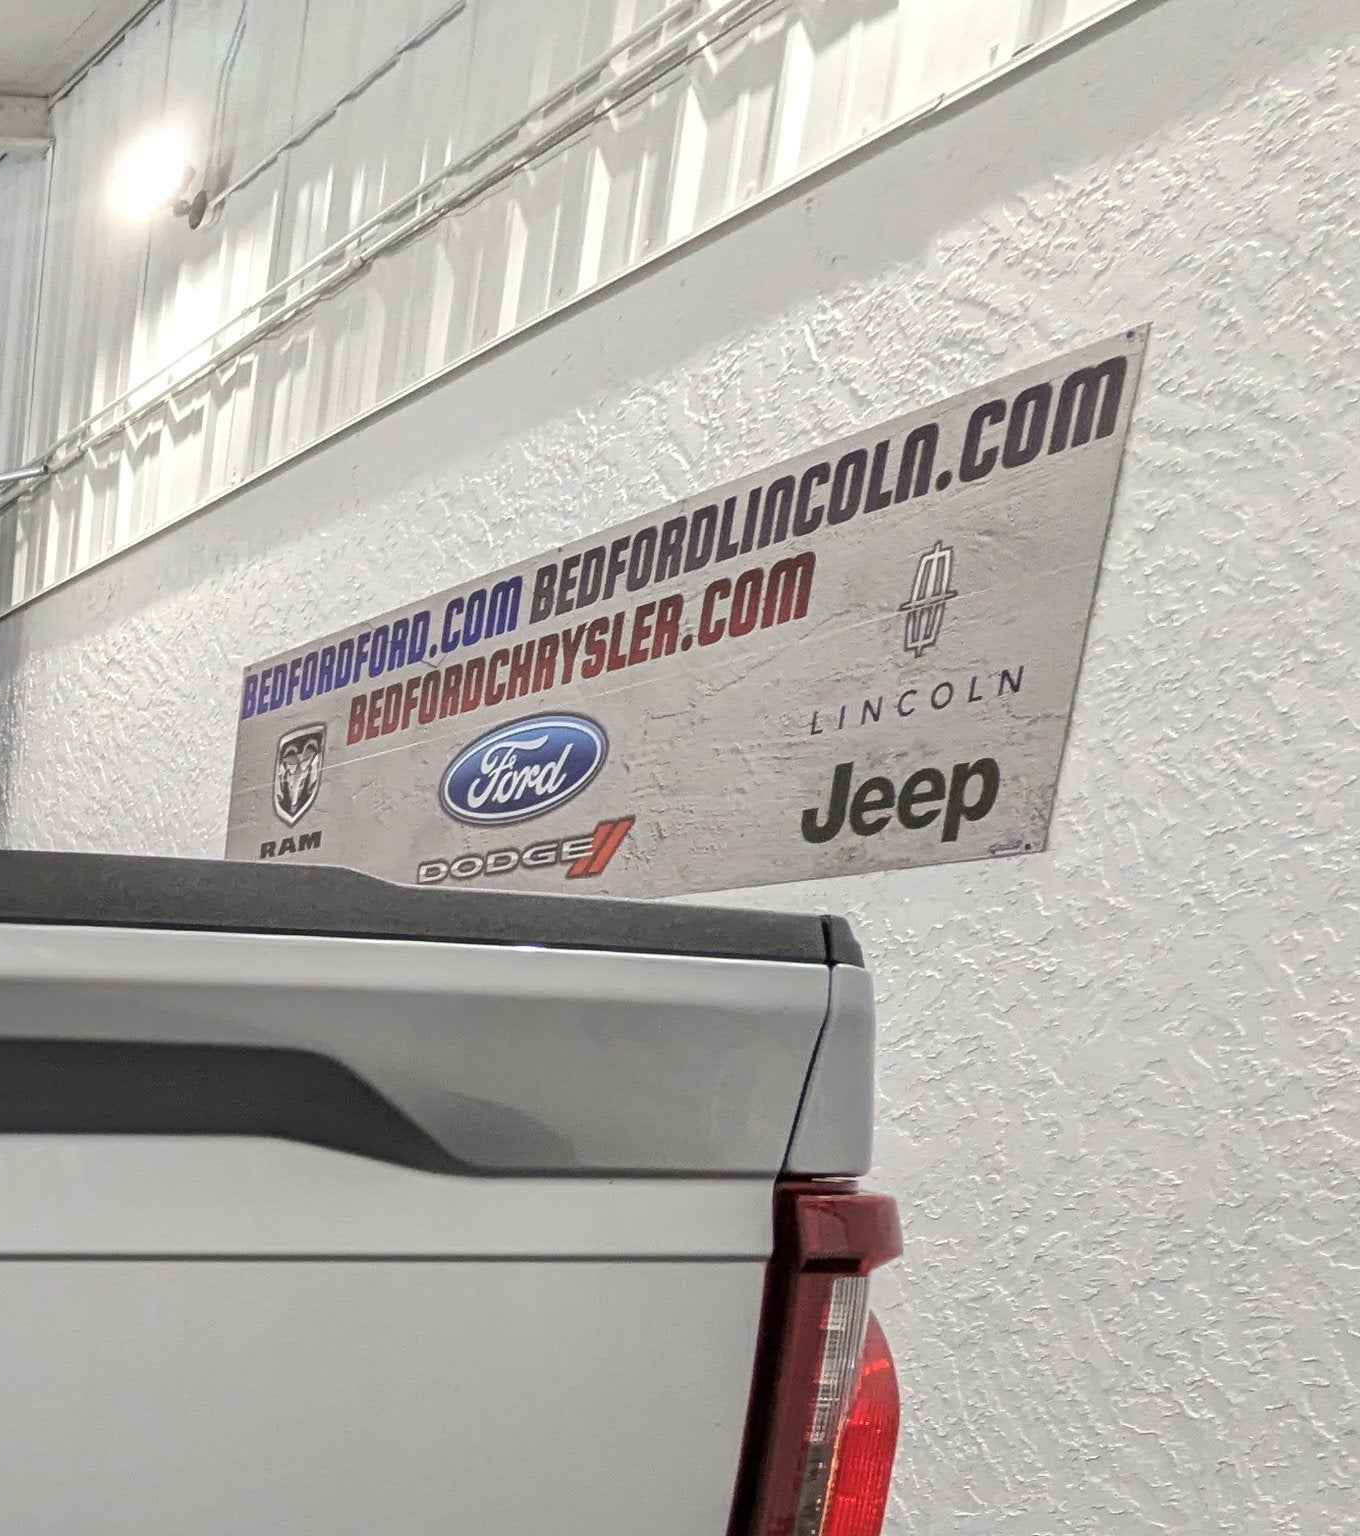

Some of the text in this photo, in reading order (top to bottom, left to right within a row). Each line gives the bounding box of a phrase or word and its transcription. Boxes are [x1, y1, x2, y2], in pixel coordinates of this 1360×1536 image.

[241, 356, 1128, 720] BEDFORDFORD.COM BEDFORDLINCOLN.COM
[346, 551, 816, 746] BEDFORDCHRYSLER.COM
[810, 665, 1025, 735] LINCOLN
[467, 734, 574, 809] Ford
[800, 757, 1001, 844] Jeep
[259, 830, 322, 860] RAM
[416, 831, 596, 885] DODGE
